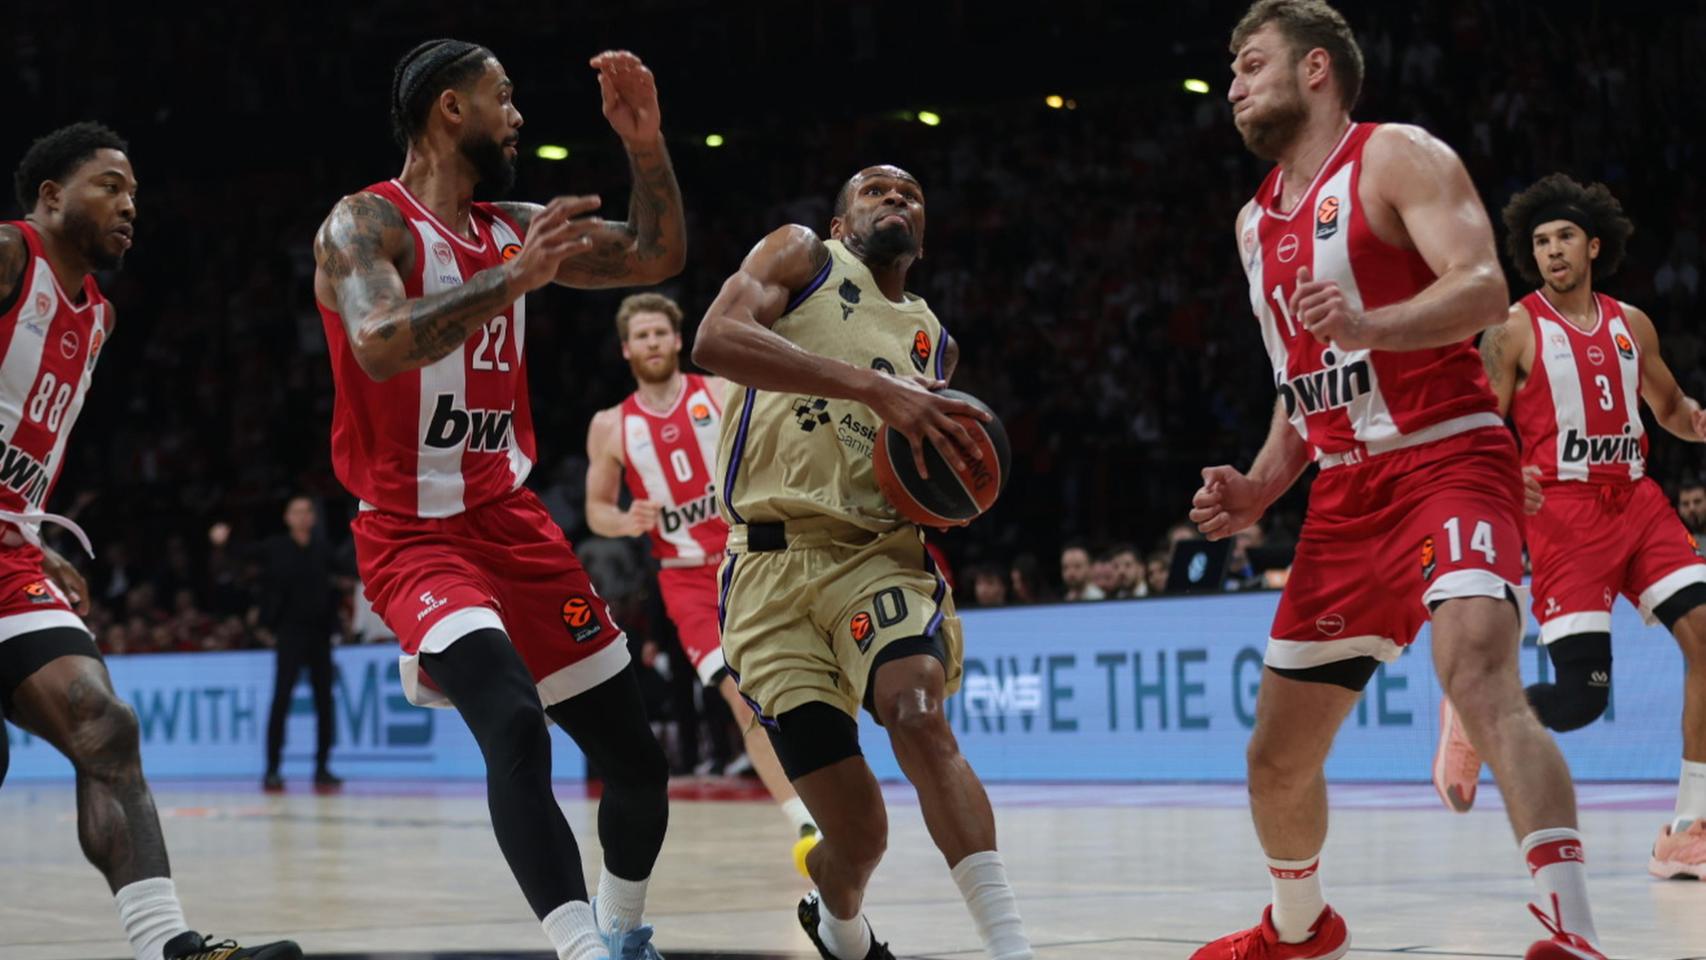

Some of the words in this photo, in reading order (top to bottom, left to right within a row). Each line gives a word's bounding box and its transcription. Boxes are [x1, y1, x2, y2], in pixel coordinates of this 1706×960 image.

[472, 316, 510, 372] 22
[29, 372, 72, 432] 88
[1594, 374, 1614, 411] 3
[424, 394, 514, 451] bw
[1561, 424, 1642, 463] bwin
[670, 448, 694, 483] 0
[1442, 516, 1497, 565] 14
[872, 586, 909, 629] 0
[946, 654, 1078, 733] RIVE
[1095, 649, 1210, 732] THE
[1231, 644, 1413, 728] GE
[133, 687, 258, 746] WITH
